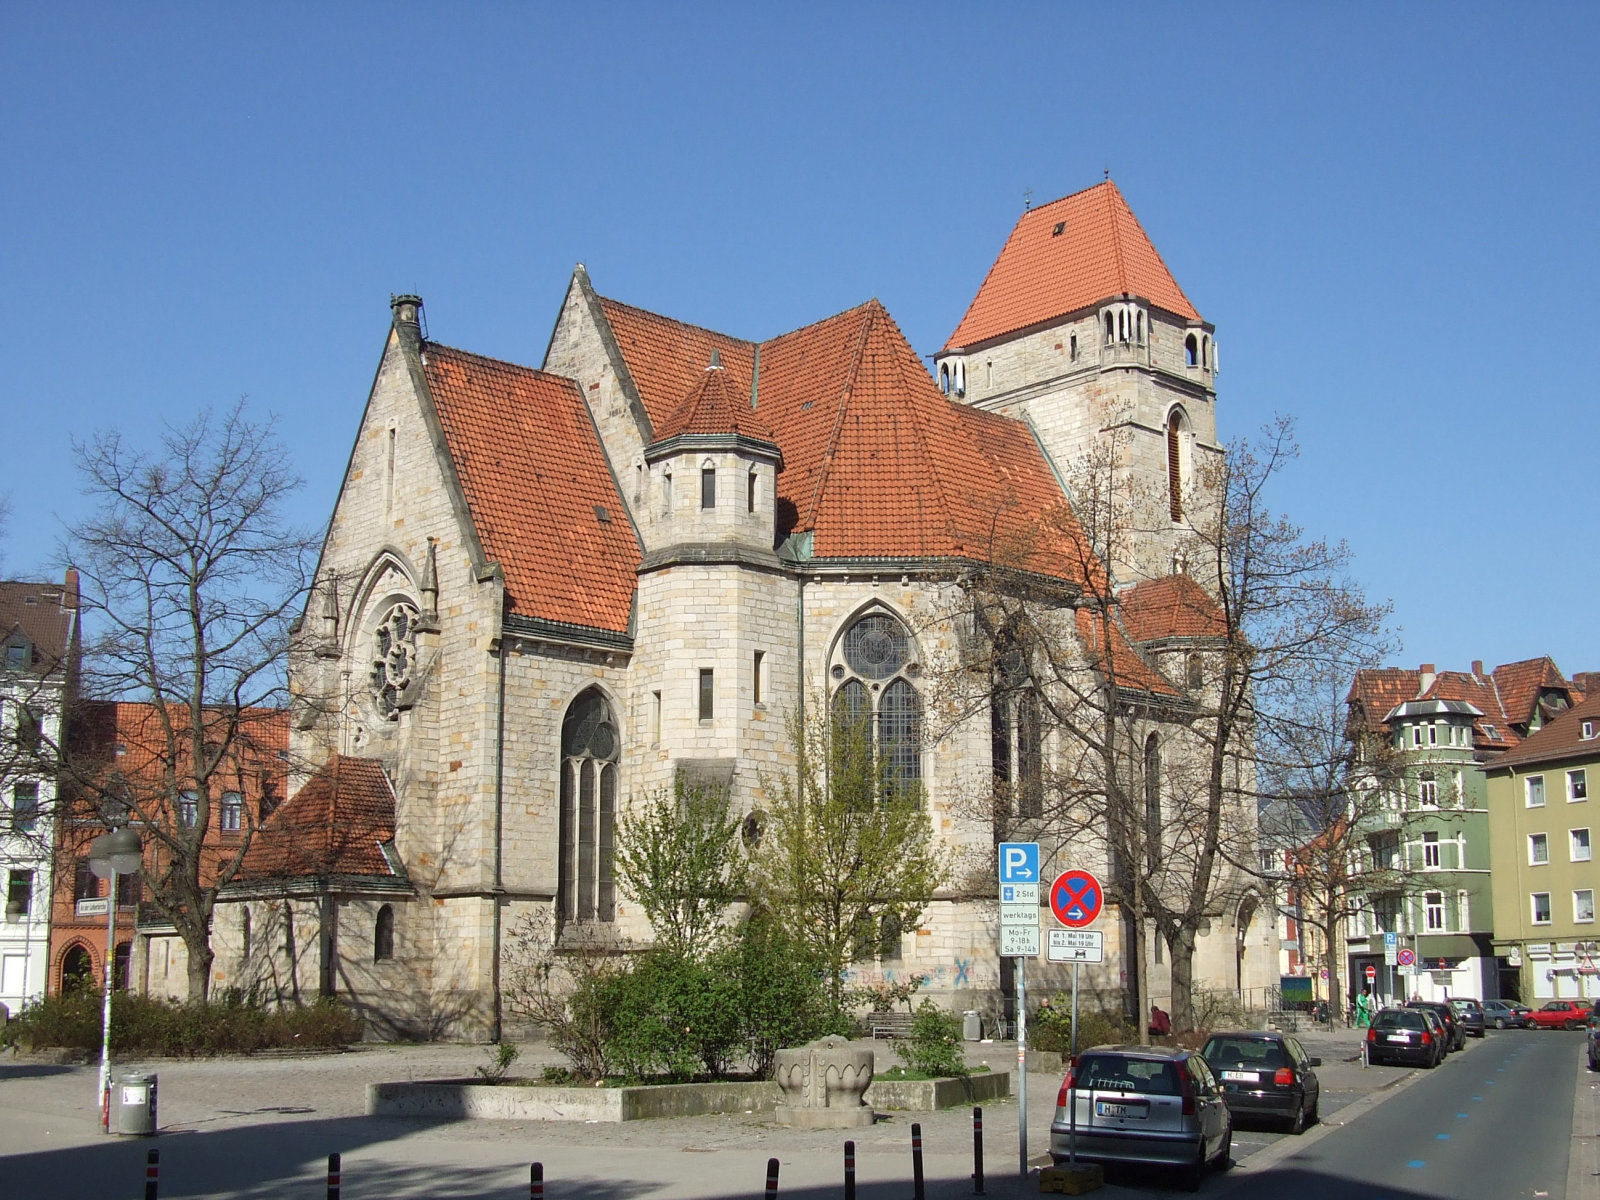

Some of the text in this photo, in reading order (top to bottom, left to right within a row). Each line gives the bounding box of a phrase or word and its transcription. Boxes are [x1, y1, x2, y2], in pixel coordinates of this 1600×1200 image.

[1005, 848, 1027, 879] P
[1016, 890, 1036, 898] 2 Std.
[1003, 911, 1037, 919] werktags
[1004, 945, 1014, 953] Sa
[1104, 1105, 1111, 1114] H
